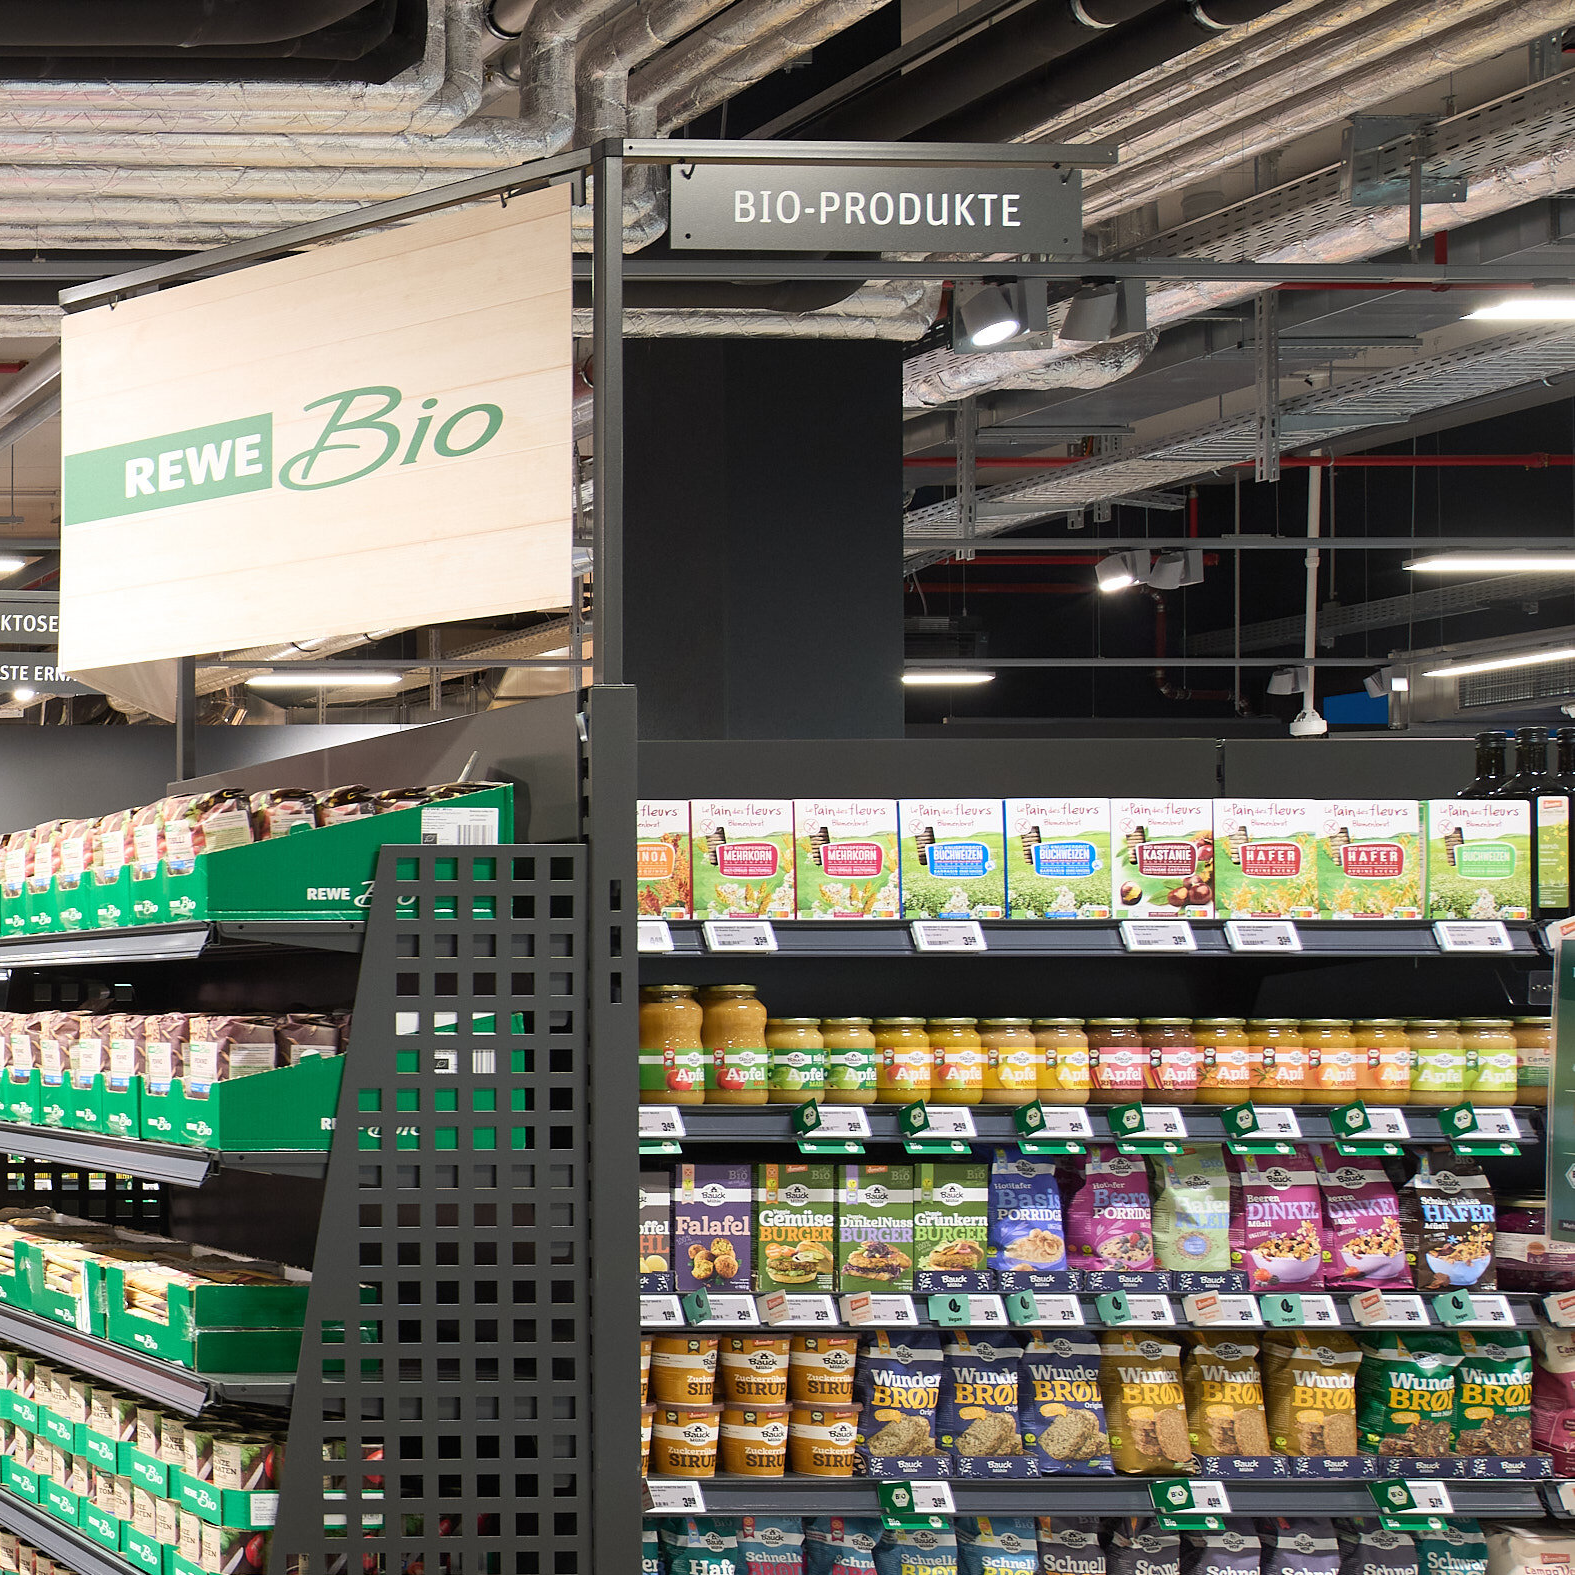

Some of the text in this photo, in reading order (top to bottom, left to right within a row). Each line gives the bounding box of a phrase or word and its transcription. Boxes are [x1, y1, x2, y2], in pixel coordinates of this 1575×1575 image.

[733, 191, 1023, 229] BIO-PRODUKTE
[125, 386, 503, 498] REWE Bio
[744, 803, 782, 818] fleurs
[727, 818, 764, 827] Blumenbrot
[723, 850, 772, 862] MEHRKORN
[933, 849, 983, 861] BUCHWEIZEN
[1142, 849, 1192, 861] KASTANIE
[1246, 850, 1296, 862] HAFER
[306, 887, 351, 901] REWE
[727, 1066, 765, 1080] Apfel
[1102, 1065, 1142, 1081] Apfel
[997, 1189, 1060, 1209] Basis
[759, 1210, 833, 1227] Gemüse
[1247, 1203, 1319, 1220] DINKEL
[1424, 1204, 1495, 1223] HAFER
[676, 1216, 750, 1236] Falafel
[840, 1215, 913, 1228] DinkelNuss
[915, 1212, 988, 1227] Grünkern
[760, 1227, 833, 1242] BURGER
[872, 1369, 941, 1386] Wunder
[736, 1381, 786, 1396] SIRUP
[871, 1385, 939, 1408] BRØD
[897, 1460, 923, 1469] Bauck
[183, 1483, 217, 1513] REWE Bio
